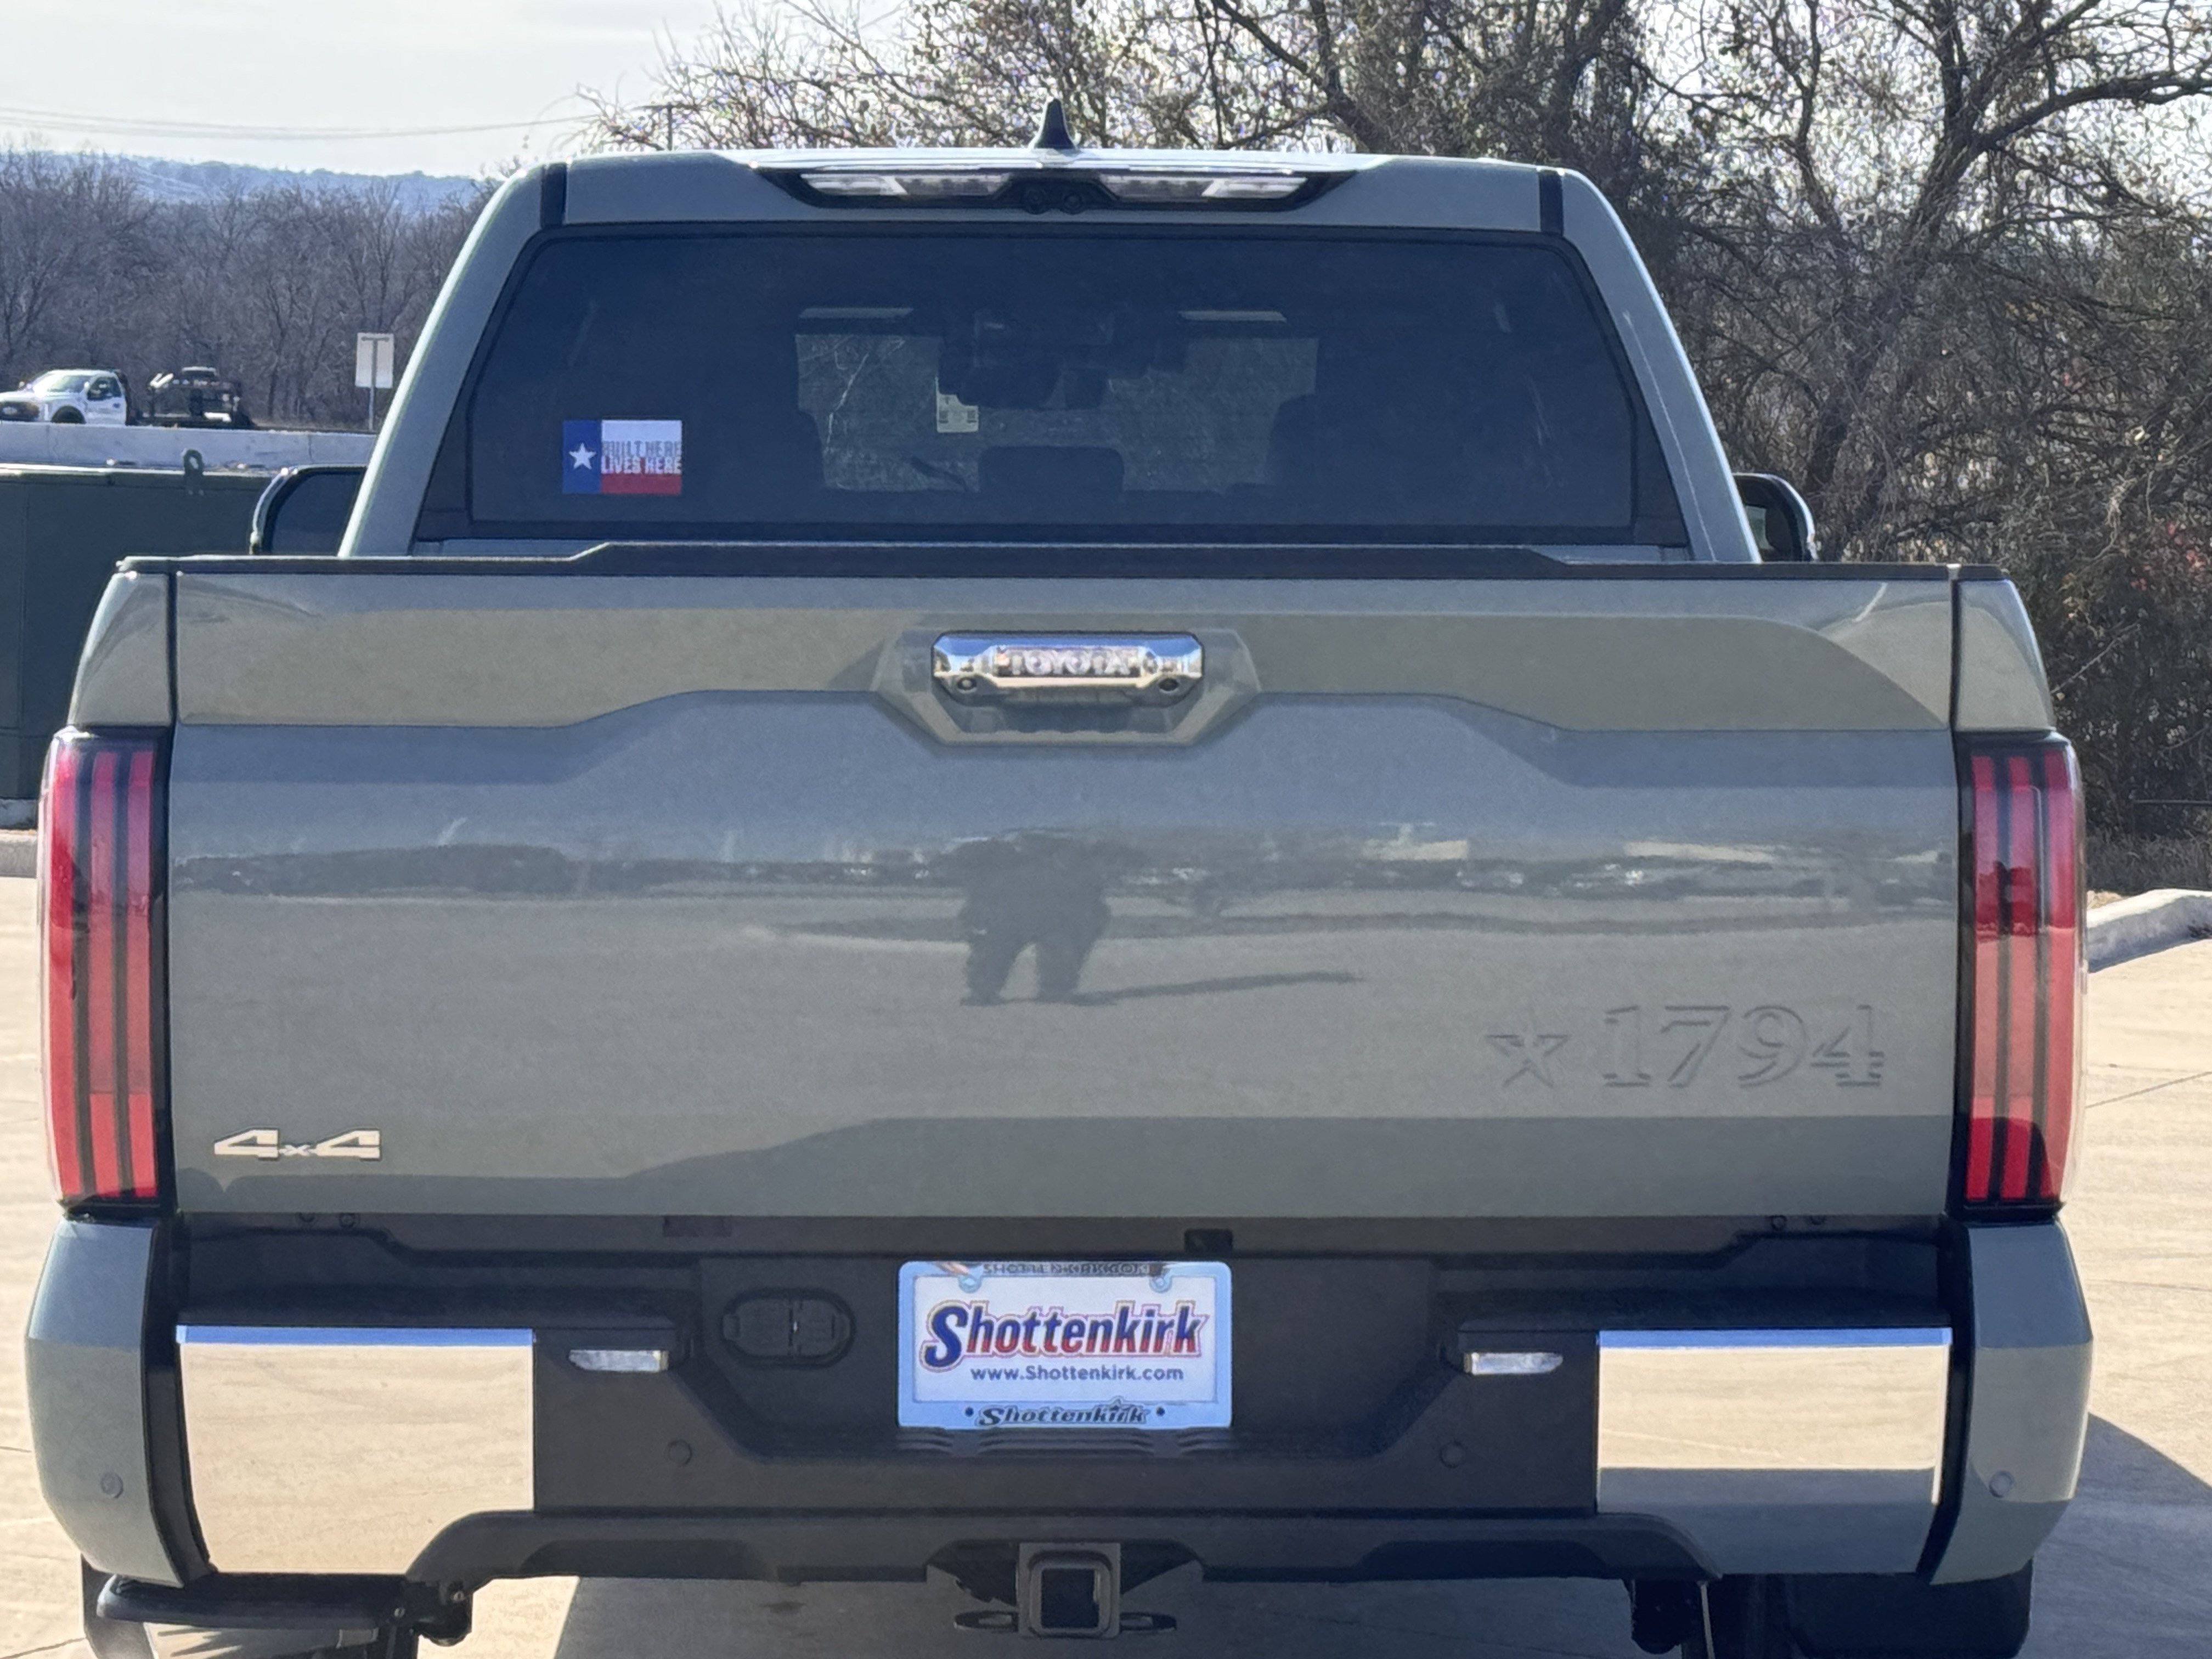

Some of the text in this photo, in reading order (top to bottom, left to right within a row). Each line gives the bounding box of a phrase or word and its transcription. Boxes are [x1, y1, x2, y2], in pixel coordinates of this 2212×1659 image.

[645, 441, 681, 456] HERE
[601, 456, 682, 474] LIVES HERE
[1602, 1005, 1884, 1088] 1794
[922, 1302, 1205, 1369] Shottenkirk
[970, 1364, 1184, 1381] www.Shottenkirk.com
[978, 1404, 1147, 1426] Shottenkirk
